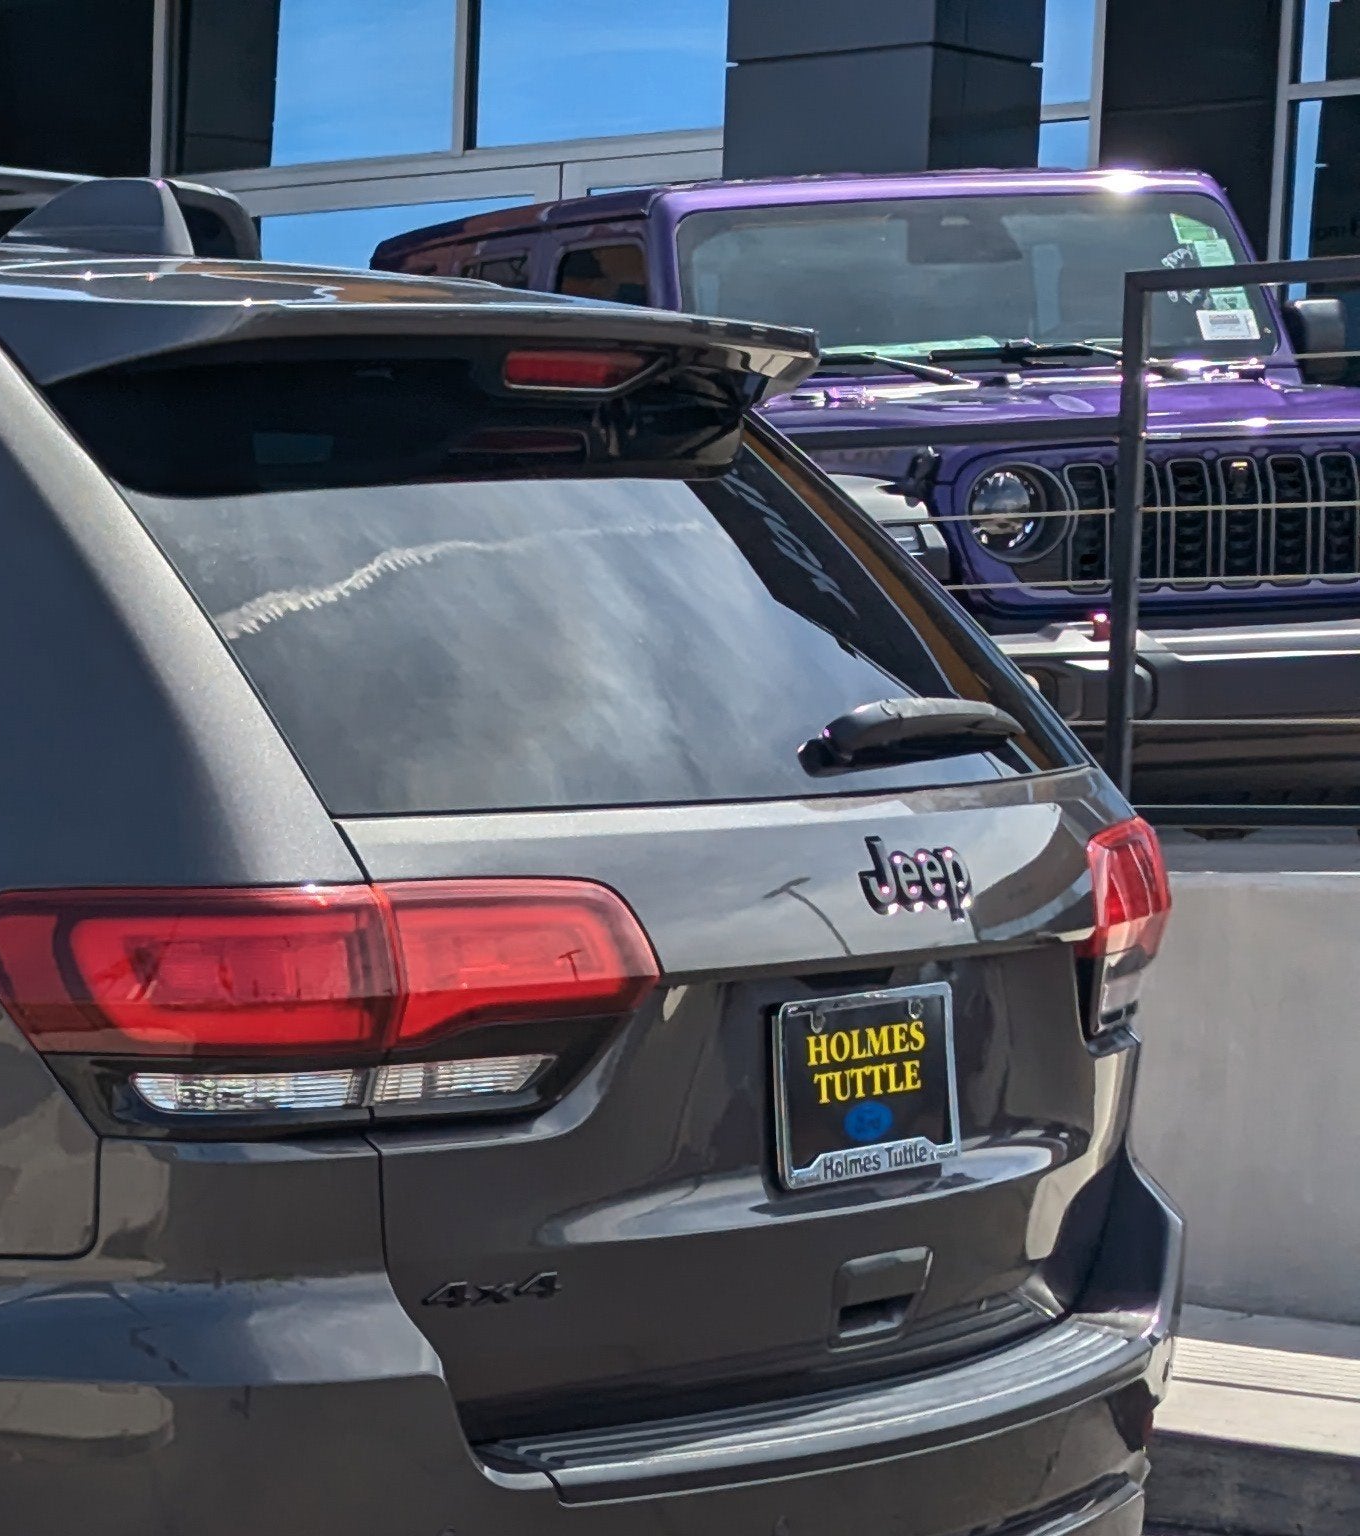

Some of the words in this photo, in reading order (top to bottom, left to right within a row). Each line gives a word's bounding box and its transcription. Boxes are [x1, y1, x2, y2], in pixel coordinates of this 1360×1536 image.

[857, 836, 972, 922] Jeep
[805, 1019, 926, 1067] HOLMES
[813, 1060, 922, 1105] TUTTLE
[823, 1153, 882, 1180] Holmes
[884, 1143, 928, 1169] Tuttle
[420, 1271, 563, 1308] 4x4
